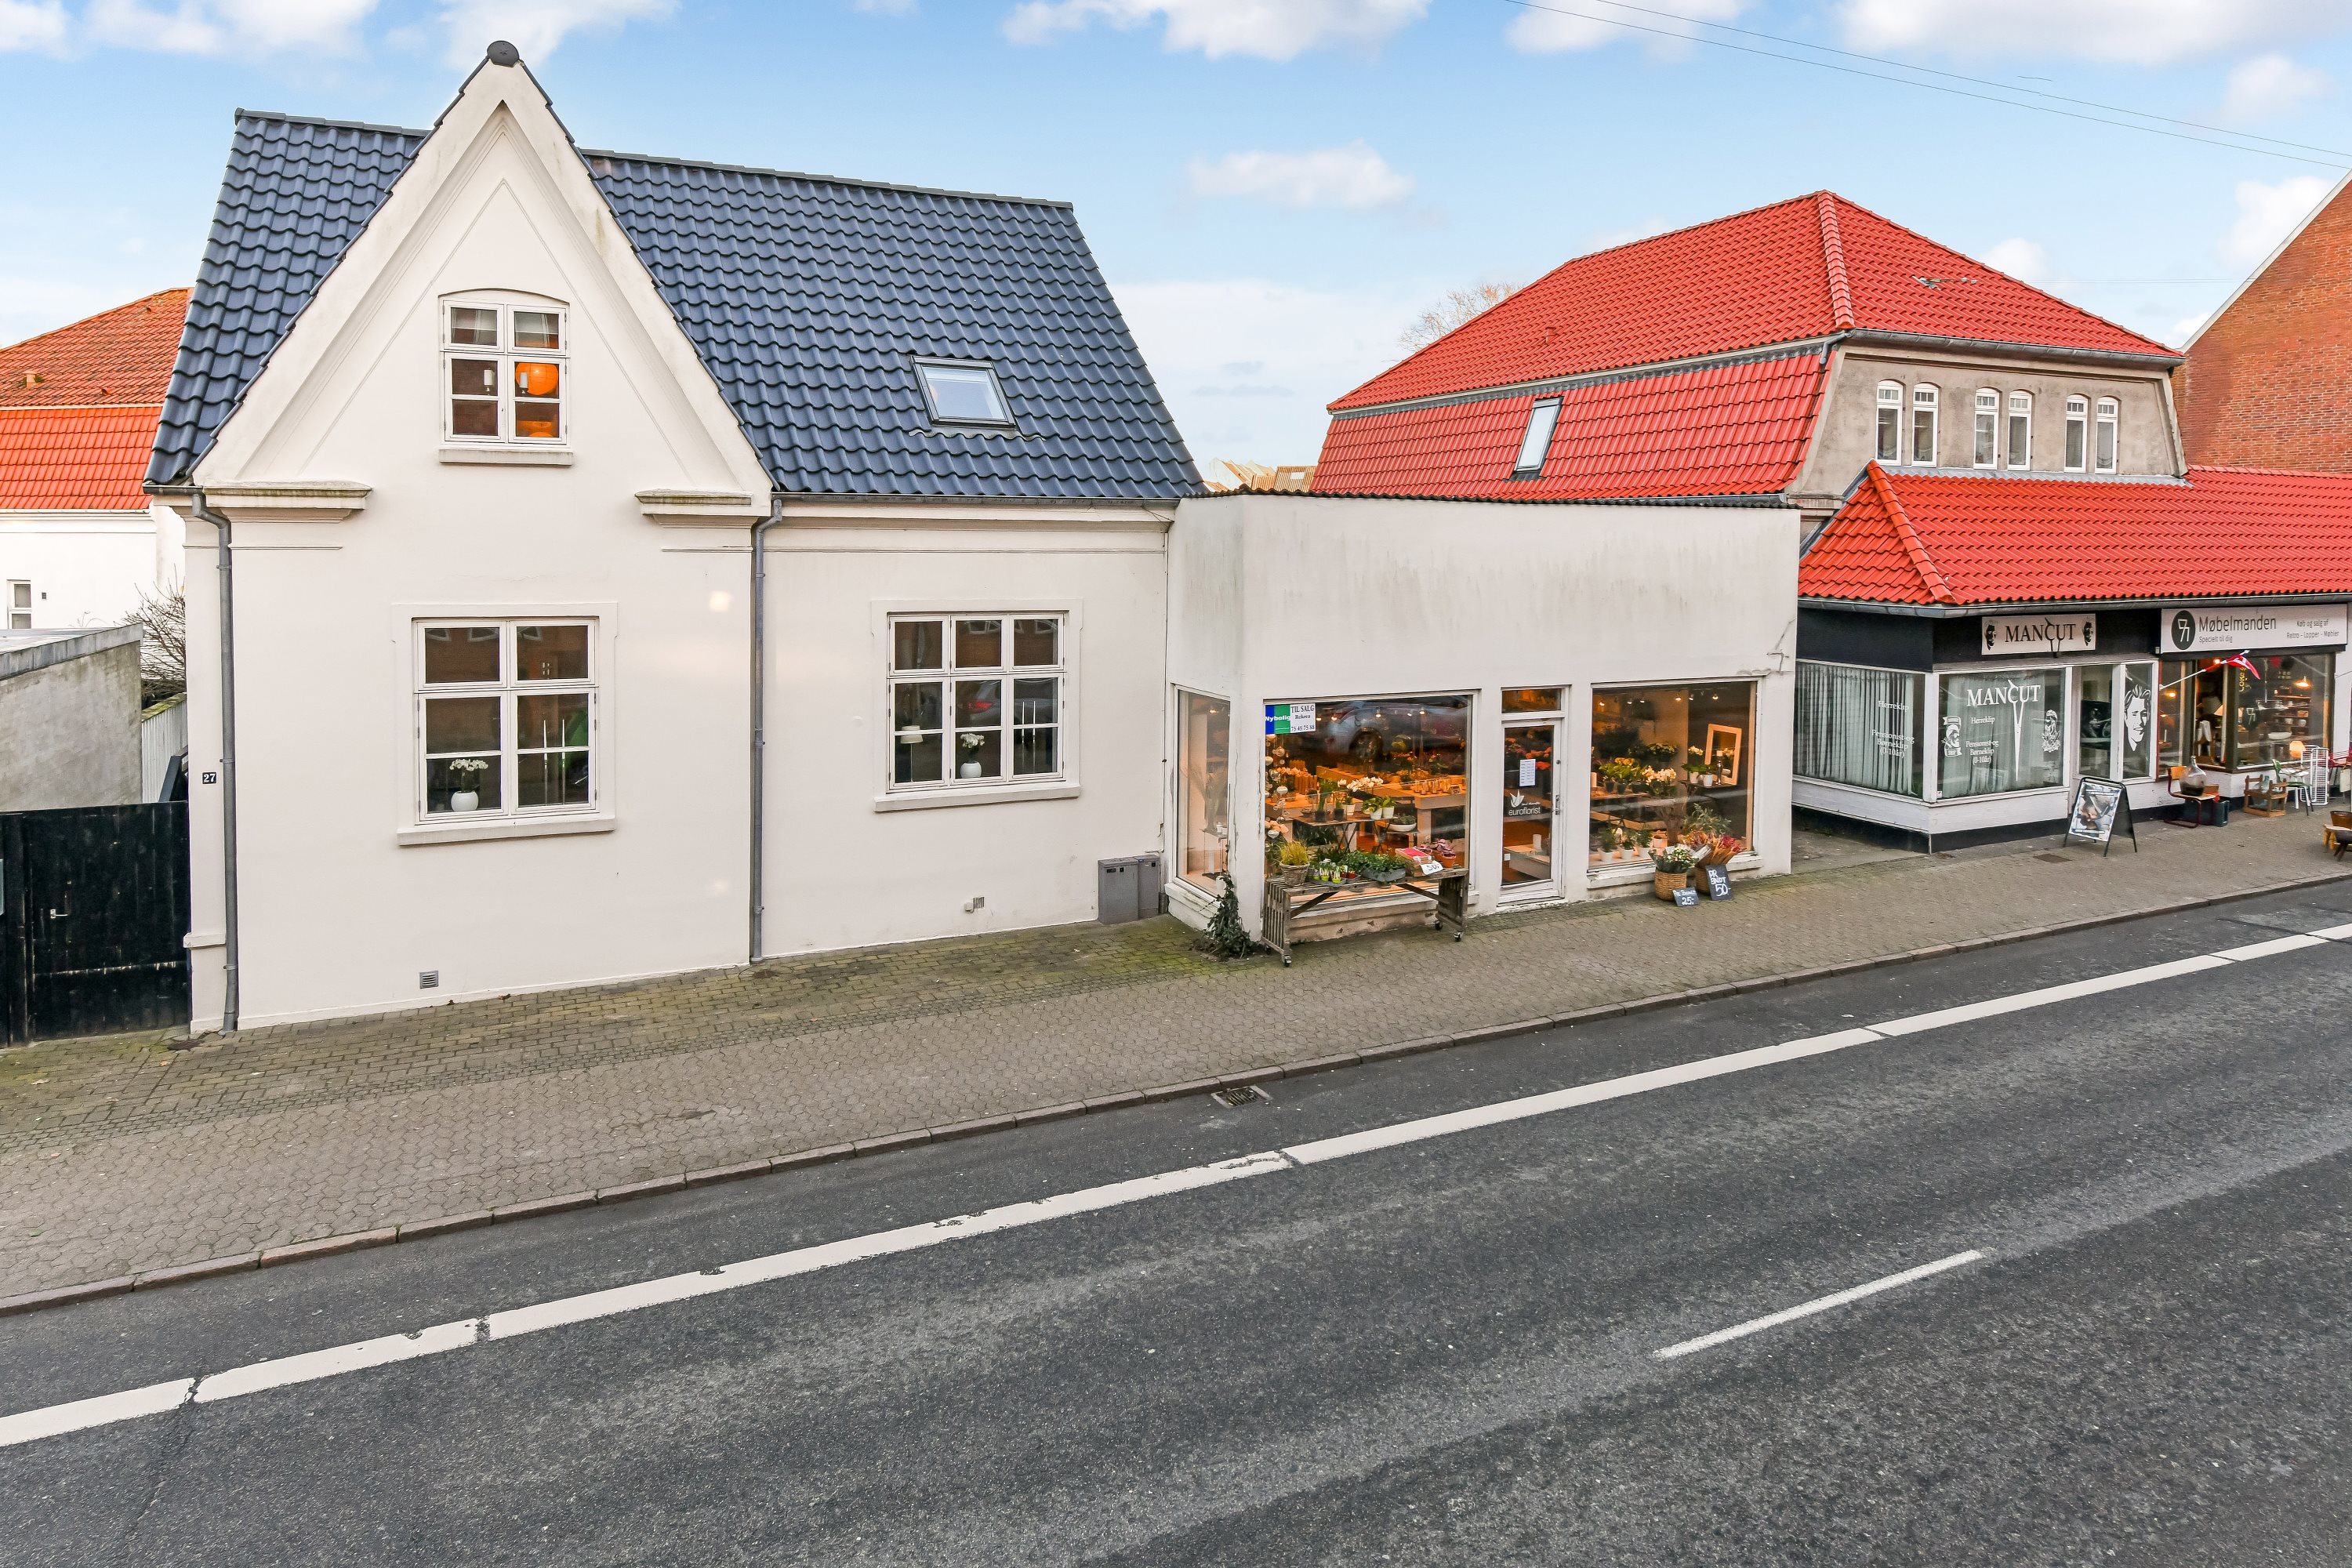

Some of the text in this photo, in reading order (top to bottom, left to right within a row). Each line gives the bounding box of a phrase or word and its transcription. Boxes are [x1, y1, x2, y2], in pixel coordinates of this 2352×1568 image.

[2198, 615, 2277, 633] Møbelmanden
[2314, 619, 2323, 628] salg
[2004, 621, 2076, 642] MANCUT
[2198, 635, 2219, 644] Specielt
[1966, 683, 2041, 706] MANCUT
[1878, 700, 1910, 713] Herreklip
[1970, 715, 1995, 724] Herreklip
[203, 773, 216, 782] 27
[1508, 807, 1541, 816] euroflorist
